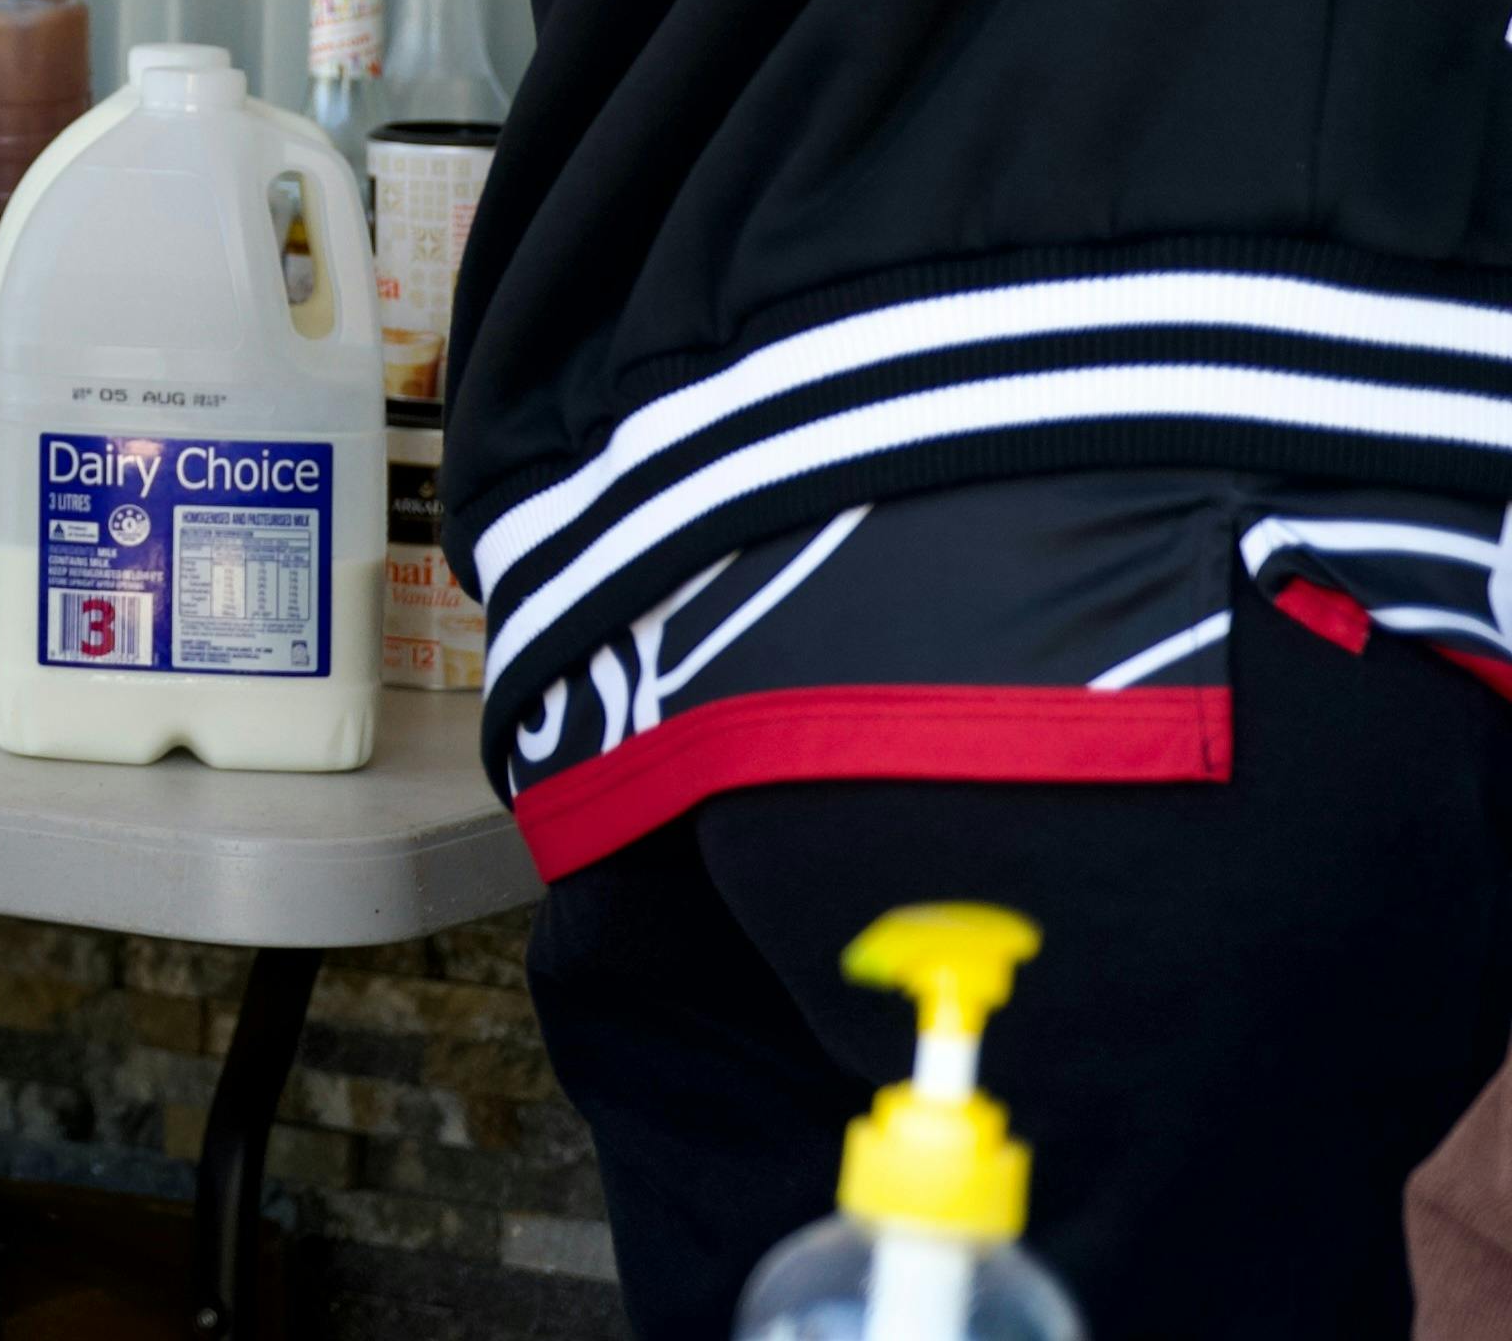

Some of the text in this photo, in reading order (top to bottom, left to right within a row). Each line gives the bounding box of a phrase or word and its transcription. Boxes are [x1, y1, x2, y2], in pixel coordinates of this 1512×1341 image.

[142, 390, 186, 406] AUG
[49, 441, 320, 498] Dairy Choice
[49, 492, 92, 512] 3 LITRES
[392, 588, 462, 608] Vanilla
[80, 597, 116, 658] 3
[411, 646, 435, 668] 12
